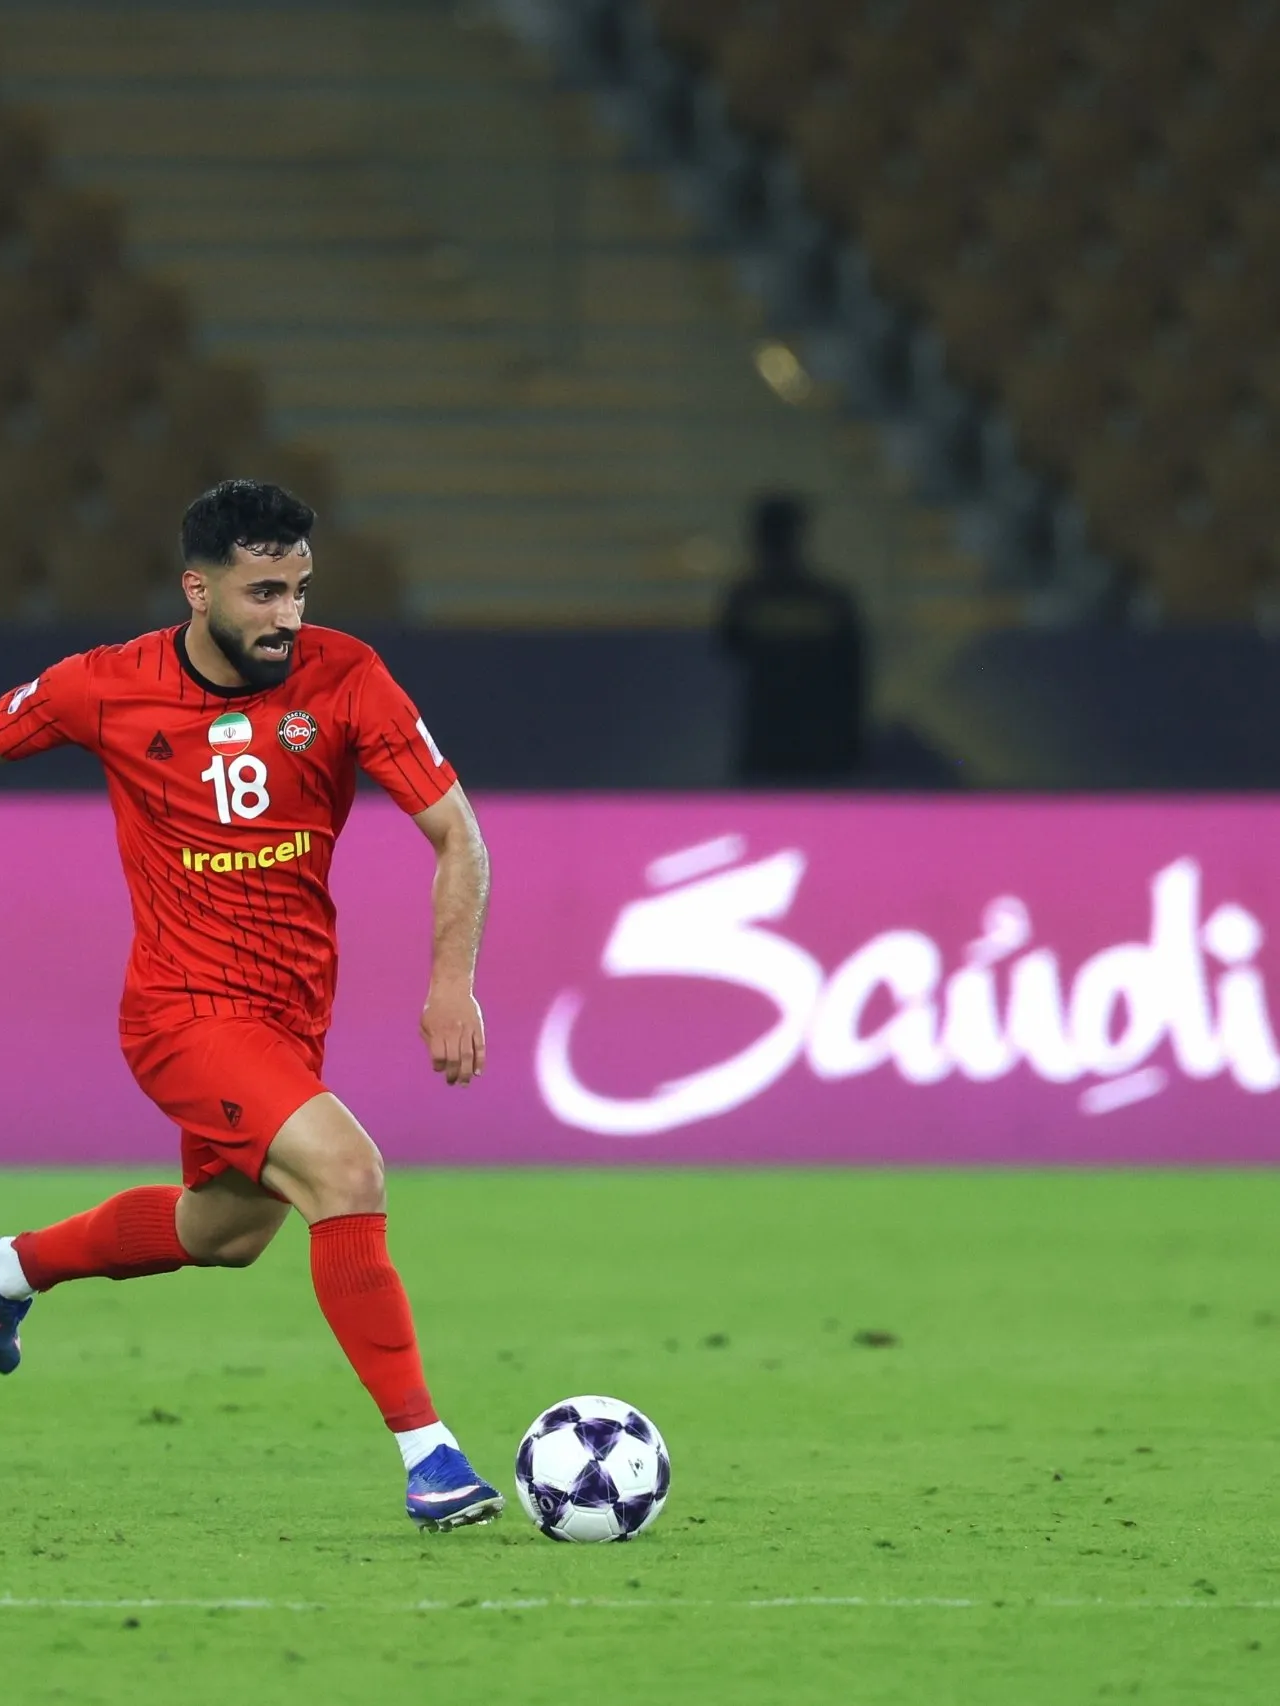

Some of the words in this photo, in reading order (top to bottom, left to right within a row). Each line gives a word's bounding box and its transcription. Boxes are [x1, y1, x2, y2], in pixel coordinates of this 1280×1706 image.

[201, 754, 270, 824] 18
[182, 831, 310, 872] Irancell
[534, 832, 1280, 1137] Saudi
